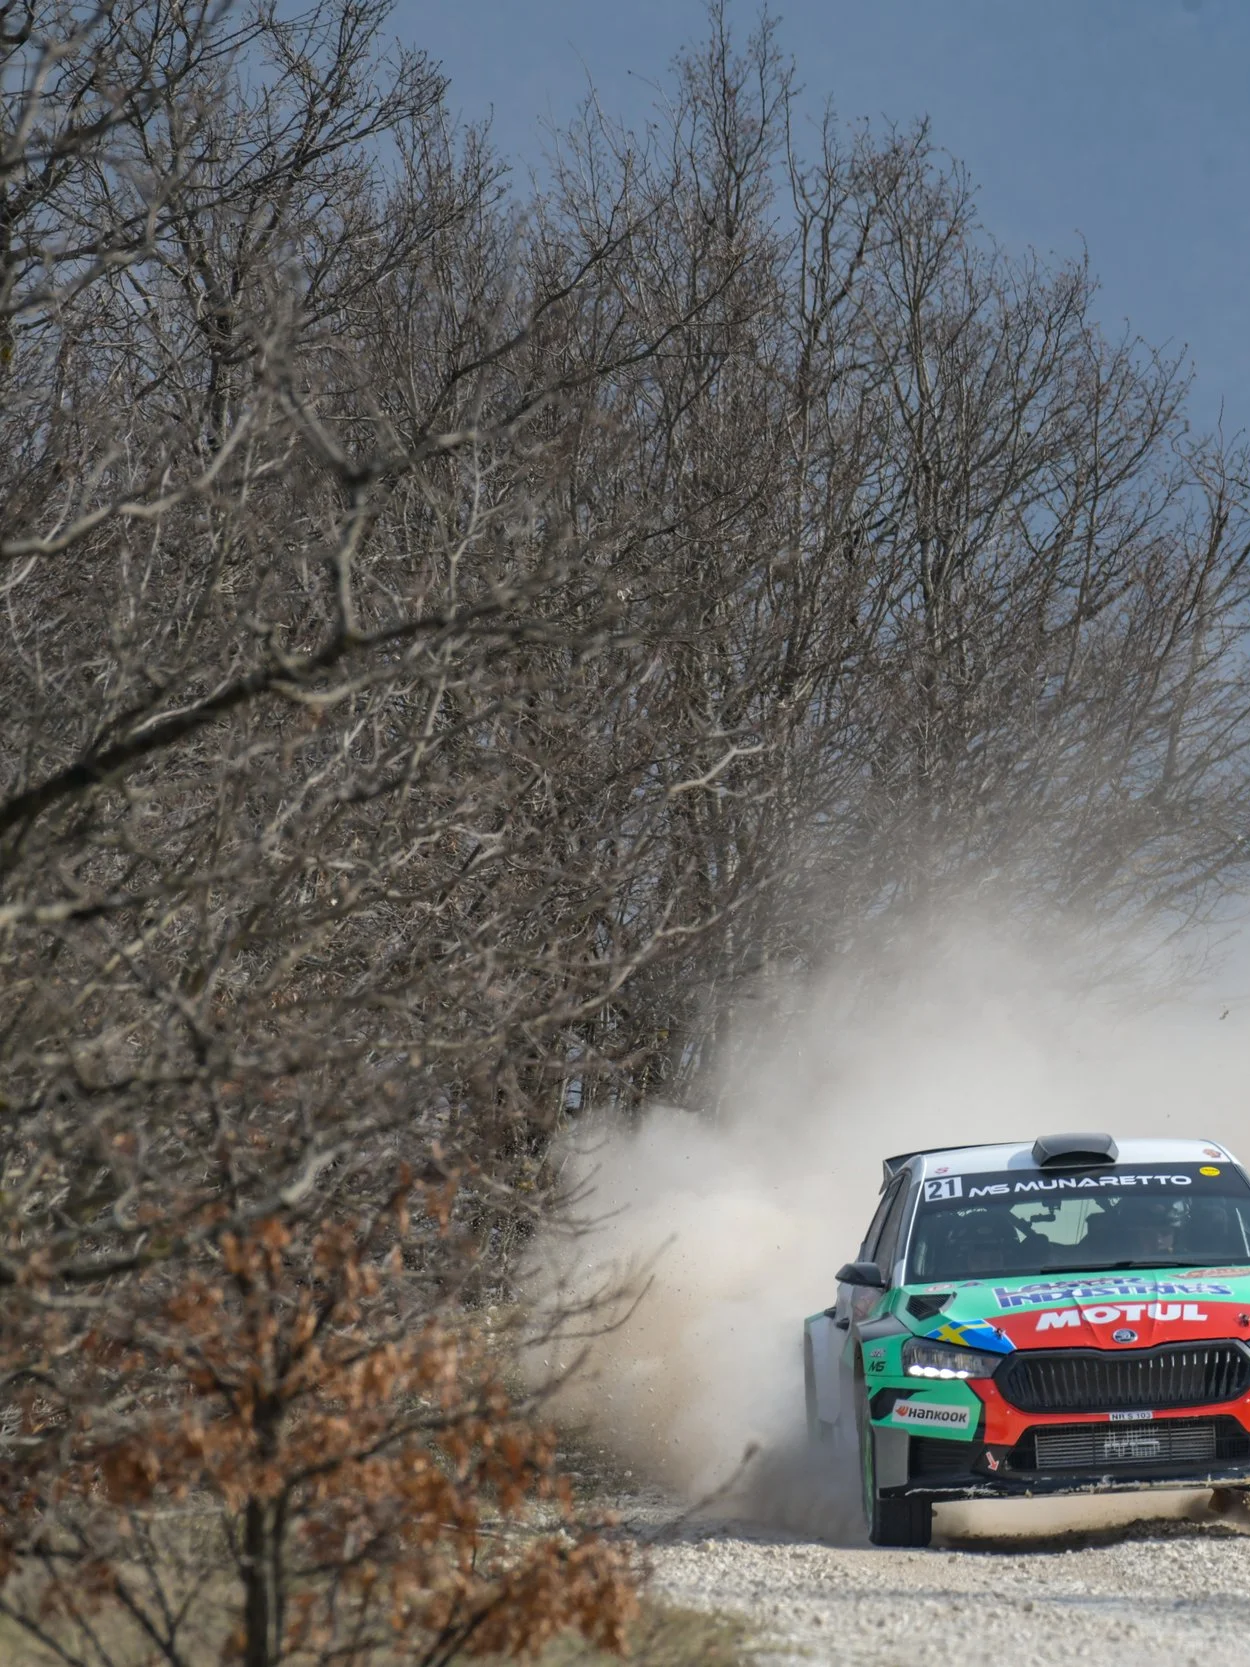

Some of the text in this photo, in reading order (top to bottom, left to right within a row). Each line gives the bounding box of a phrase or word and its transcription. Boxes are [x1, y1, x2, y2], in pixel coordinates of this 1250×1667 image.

[928, 1175, 1192, 1200] 21 MS MUNARETTO
[1035, 1303, 1208, 1331] MOTUL
